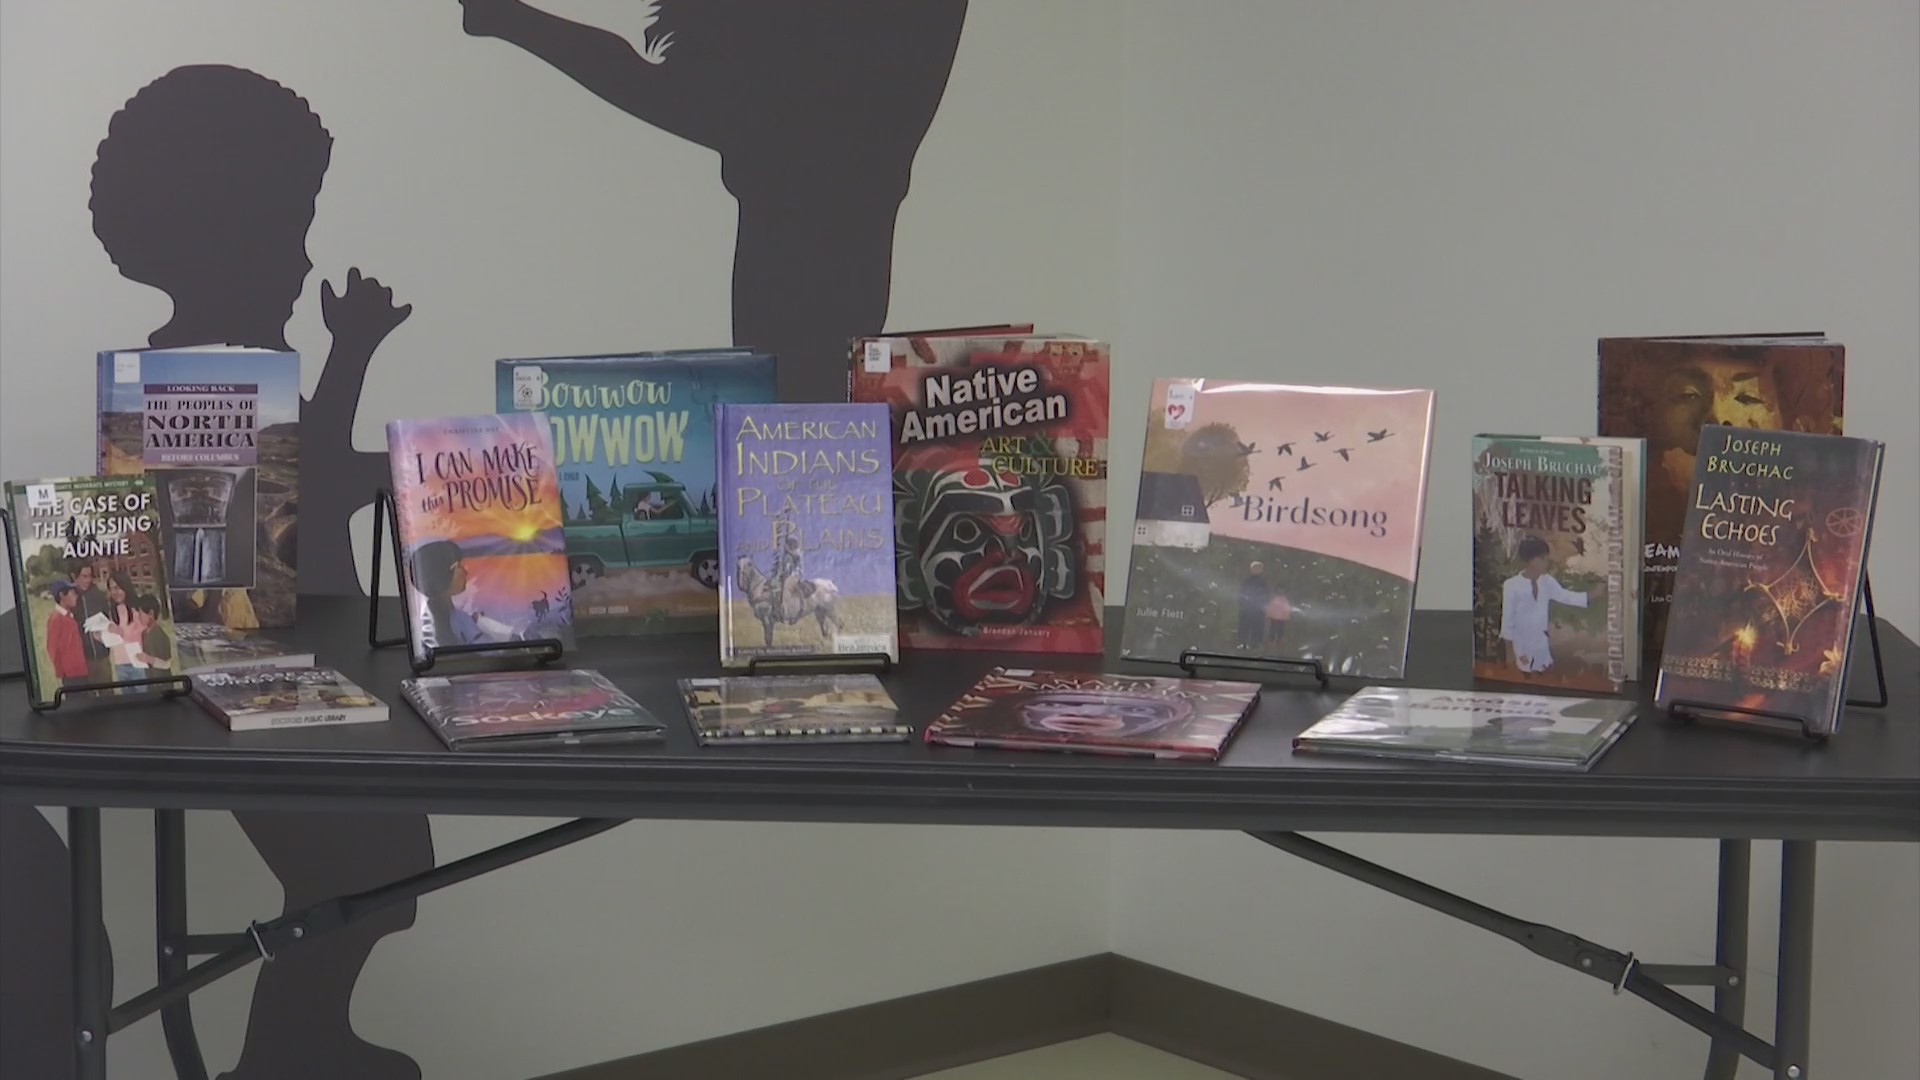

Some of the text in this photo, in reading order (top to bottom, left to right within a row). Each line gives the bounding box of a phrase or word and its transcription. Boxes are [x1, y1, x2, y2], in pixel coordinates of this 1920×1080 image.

[167, 385, 235, 393] LOOKING BACK
[925, 367, 1039, 409] Native
[148, 401, 253, 411] THE PEOPLES OF
[147, 415, 254, 431] NORTH
[736, 415, 876, 441] AMERICAN
[900, 394, 1067, 444] American
[146, 433, 255, 449] AMERICA
[550, 410, 689, 468] OWWOW
[981, 436, 1025, 454] ART
[1723, 434, 1781, 456] JOSEPH
[161, 453, 240, 463] BEFORE COLUMBUS
[416, 441, 541, 484] I CAN MAKE
[737, 441, 880, 476] INDIANS
[991, 457, 1098, 477] CULTURE
[1484, 452, 1600, 475] JOSEPH BRUCHAC
[1706, 456, 1793, 480] BRUCHAC
[38, 488, 49, 499] M
[422, 475, 542, 513] this PROMISE
[1494, 471, 1592, 505] TALKING
[70, 497, 118, 514] CASE
[124, 493, 151, 512] OF
[737, 487, 881, 517] PLATEAU
[1695, 484, 1795, 521] LASTING
[32, 515, 151, 539] THE MISSING
[1243, 495, 1388, 538] Birdsong
[1502, 501, 1586, 534] LEAVES
[773, 521, 884, 552] PLAINS
[1701, 513, 1780, 546] ECHOES
[62, 538, 130, 559] AUNTIE
[1643, 542, 1680, 560] EAM
[1136, 607, 1184, 619] Julie Flett
[983, 627, 1050, 637] Brendan January
[324, 714, 346, 722] LIBRARY
